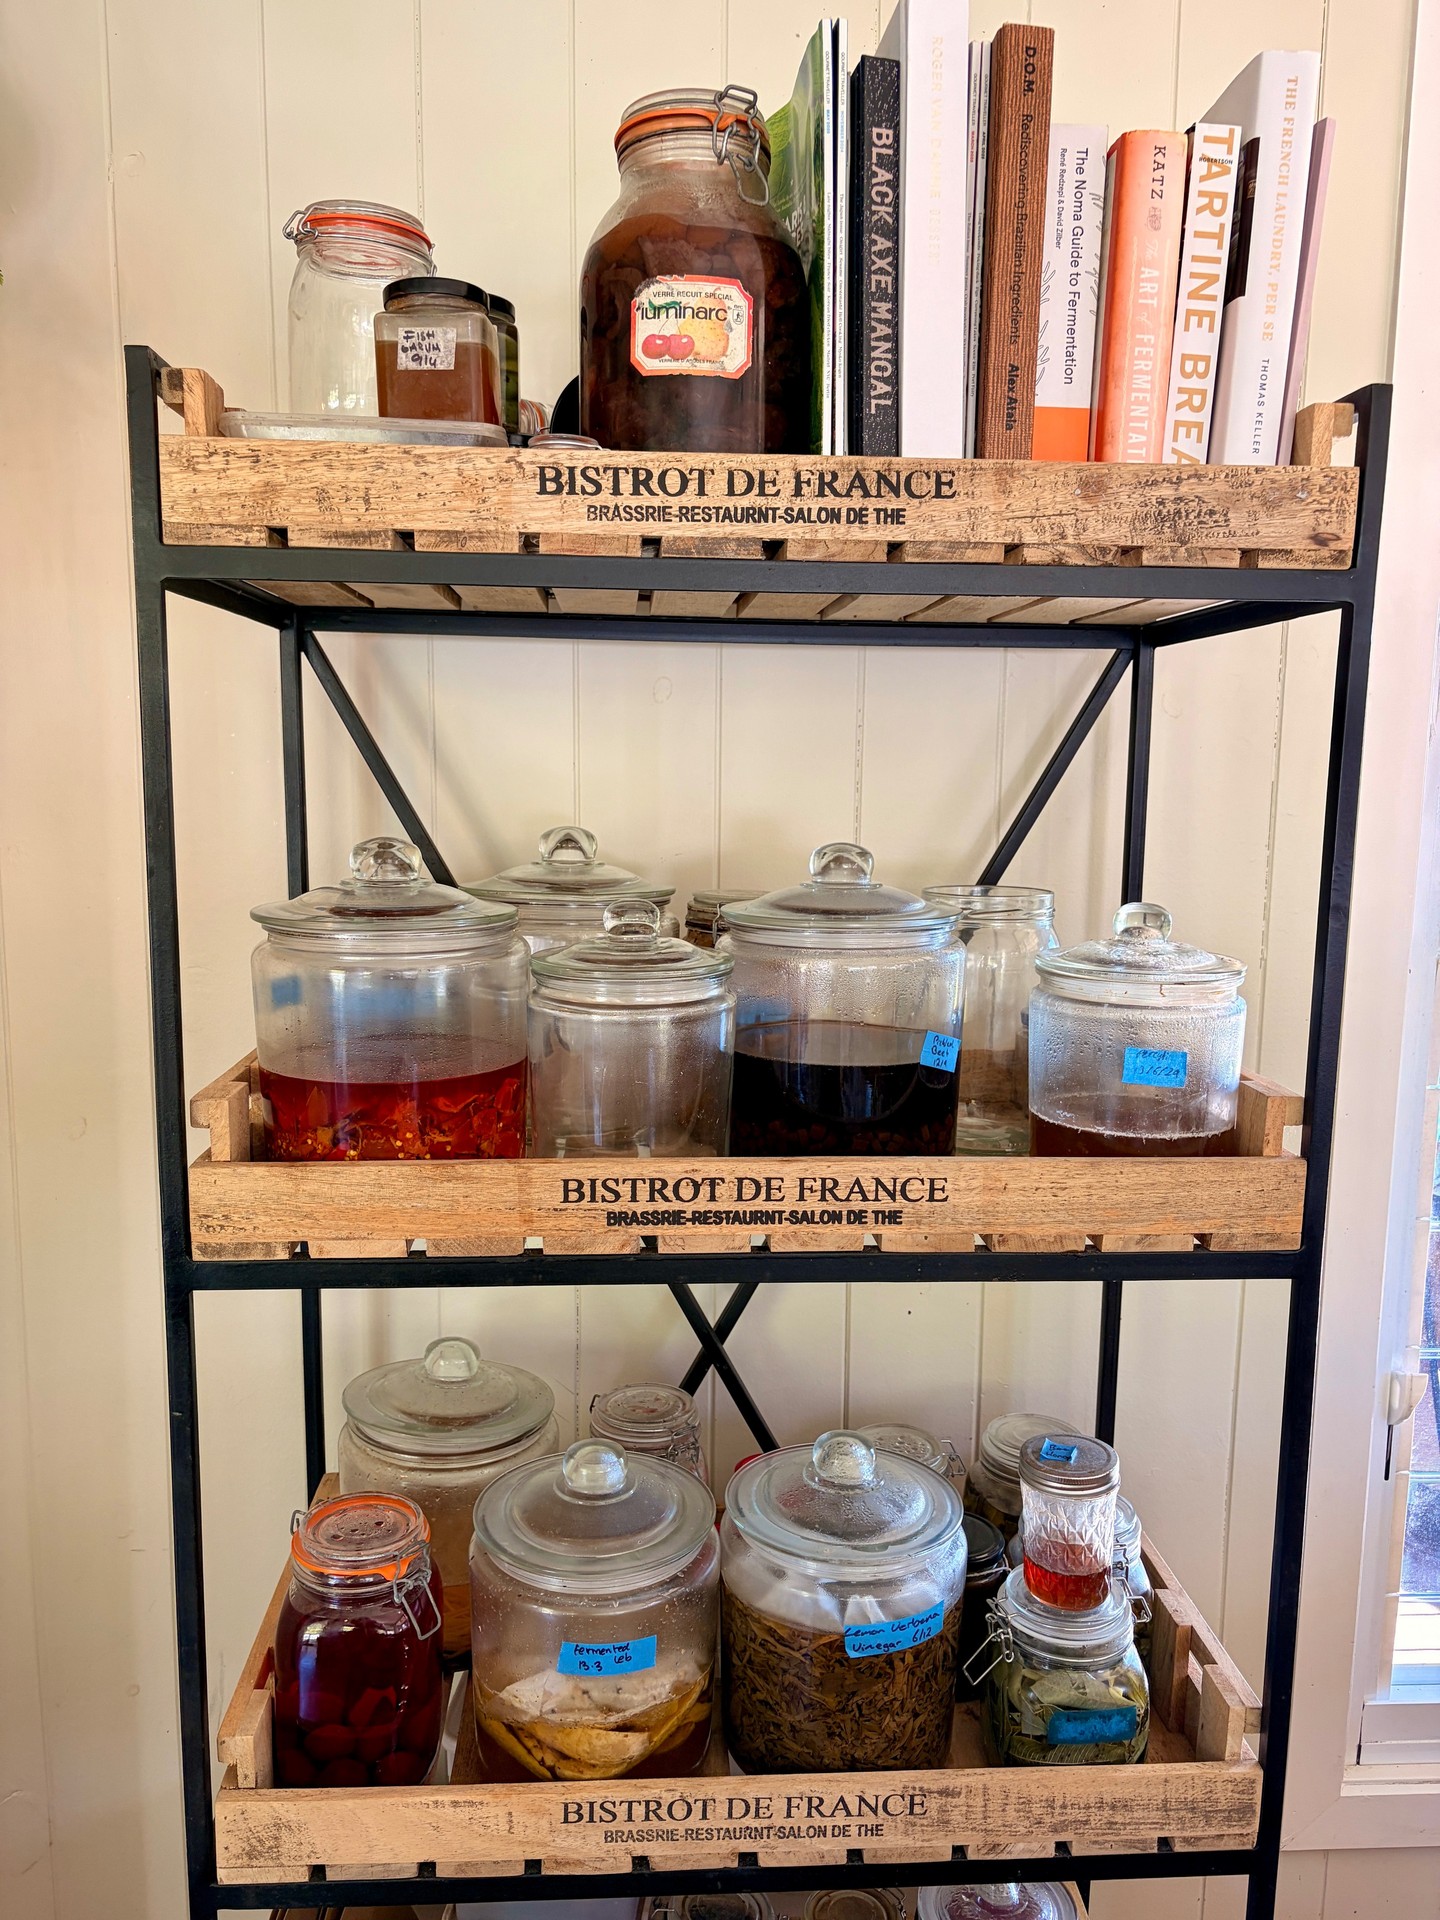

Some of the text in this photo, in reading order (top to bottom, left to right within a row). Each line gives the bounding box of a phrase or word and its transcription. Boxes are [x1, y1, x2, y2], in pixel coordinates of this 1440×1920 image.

[930, 36, 944, 92] ROGER
[1060, 148, 1068, 167] René
[1199, 156, 1233, 164] ROBERTSON
[1056, 170, 1066, 198] Redzepi
[1151, 145, 1166, 200] KATZ
[1056, 206, 1064, 226] David
[1262, 76, 1298, 342] THE FRENCH LAUNDRY, PER SE
[1005, 46, 1037, 430] D.O.M. Rediscovering Brazilian Ingredients Alex Atala
[1055, 228, 1064, 250] Zilber
[1184, 128, 1236, 334] TARTINE
[870, 127, 894, 415] BLACK AXE MANGAL
[1064, 148, 1088, 384] The Noma Guide to Fermentation
[1138, 267, 1160, 308] ART
[401, 342, 440, 353] GARUM
[403, 330, 434, 342] FISH
[1252, 358, 1270, 455] THOMAS KELLER
[536, 466, 957, 499] BISTROT DE FRANCE
[846, 507, 868, 525] DE
[874, 508, 906, 525] THE
[560, 1177, 949, 1203] BISTROT DE FRANCE
[846, 1210, 868, 1225] DE
[872, 1210, 904, 1225] THE
[844, 1628, 885, 1638] Lemon
[852, 1640, 902, 1652] Vinegar
[560, 1794, 928, 1824] BISTROT DE FRANCE
[831, 1824, 852, 1838] DE
[857, 1824, 884, 1838] THE
